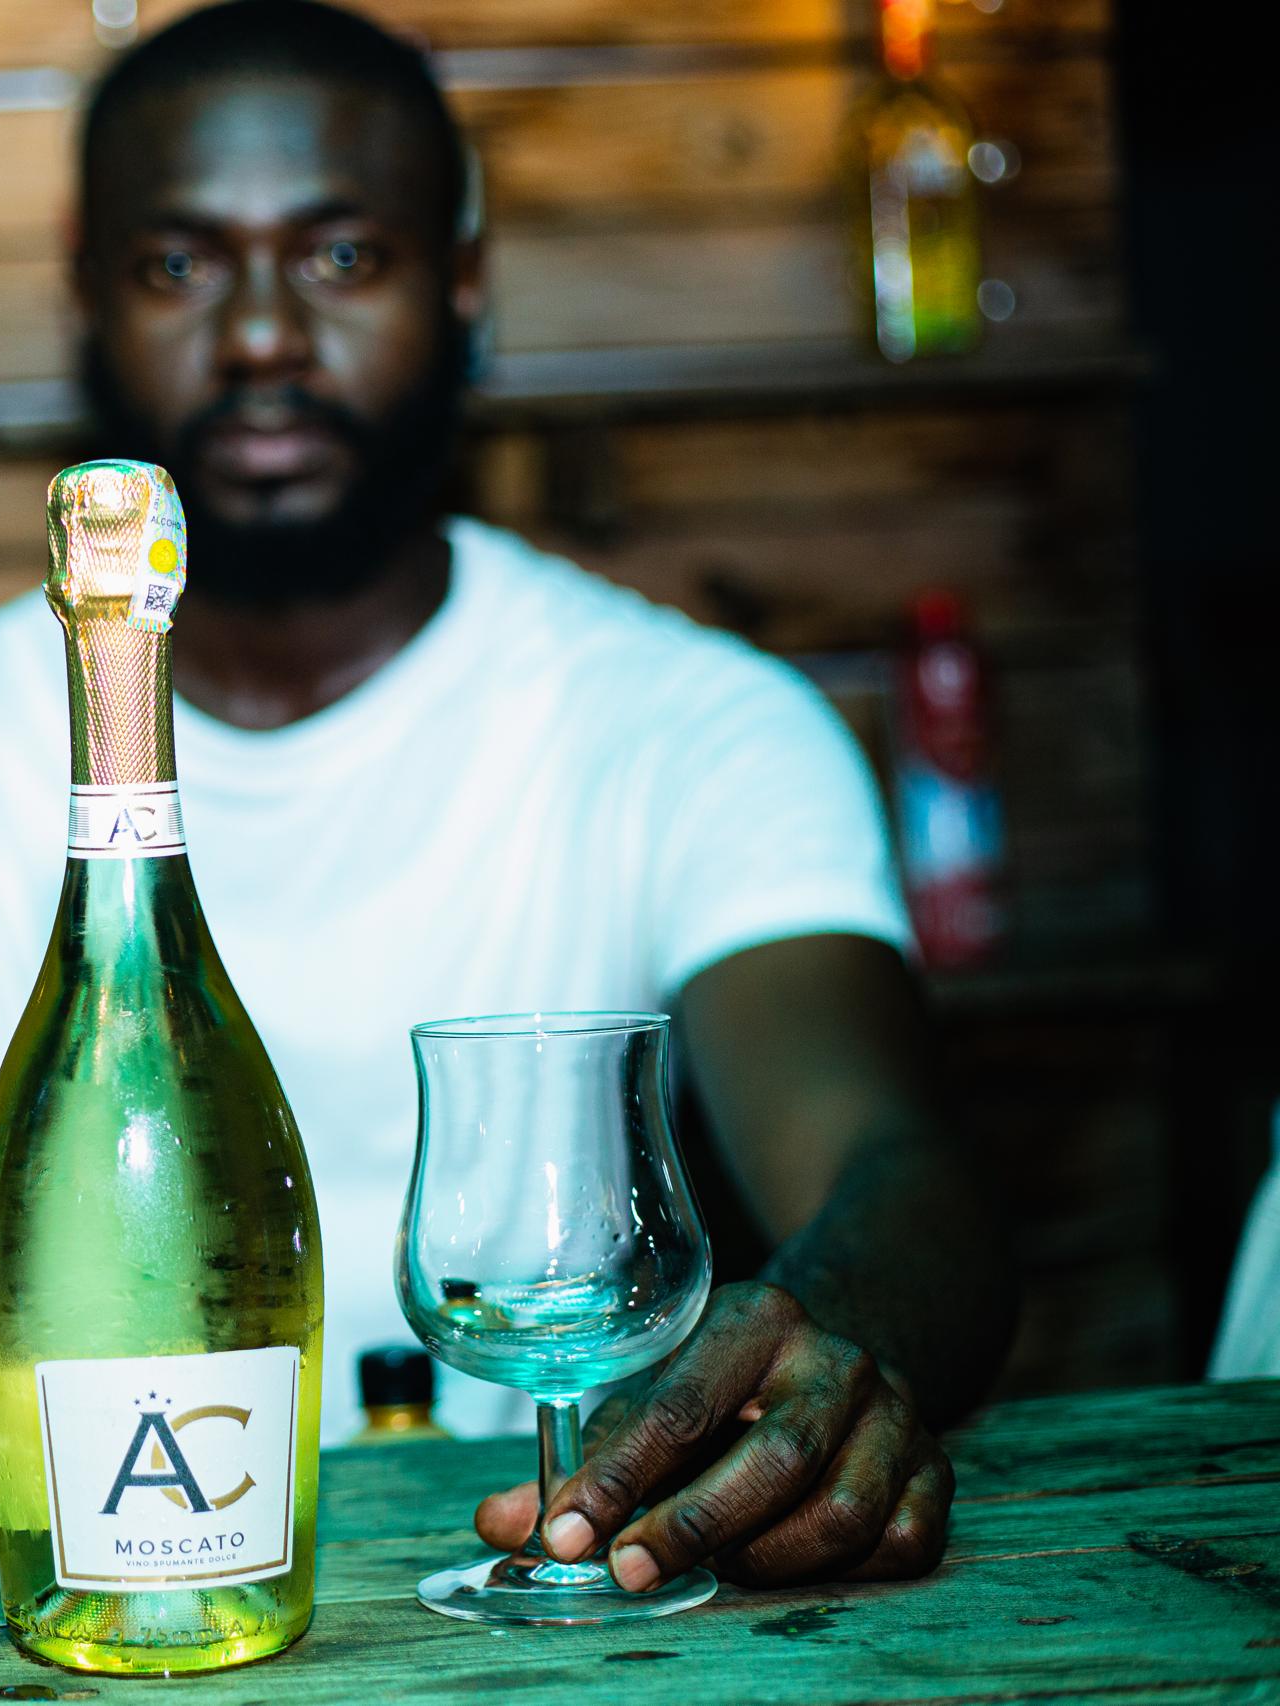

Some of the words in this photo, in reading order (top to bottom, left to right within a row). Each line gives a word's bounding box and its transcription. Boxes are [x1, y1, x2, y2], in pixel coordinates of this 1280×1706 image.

[98, 1404, 257, 1515] AC
[115, 1531, 245, 1556] MOSCATO
[153, 1557, 205, 1567] SPUMANTE
[208, 1552, 237, 1563] DOLCE
